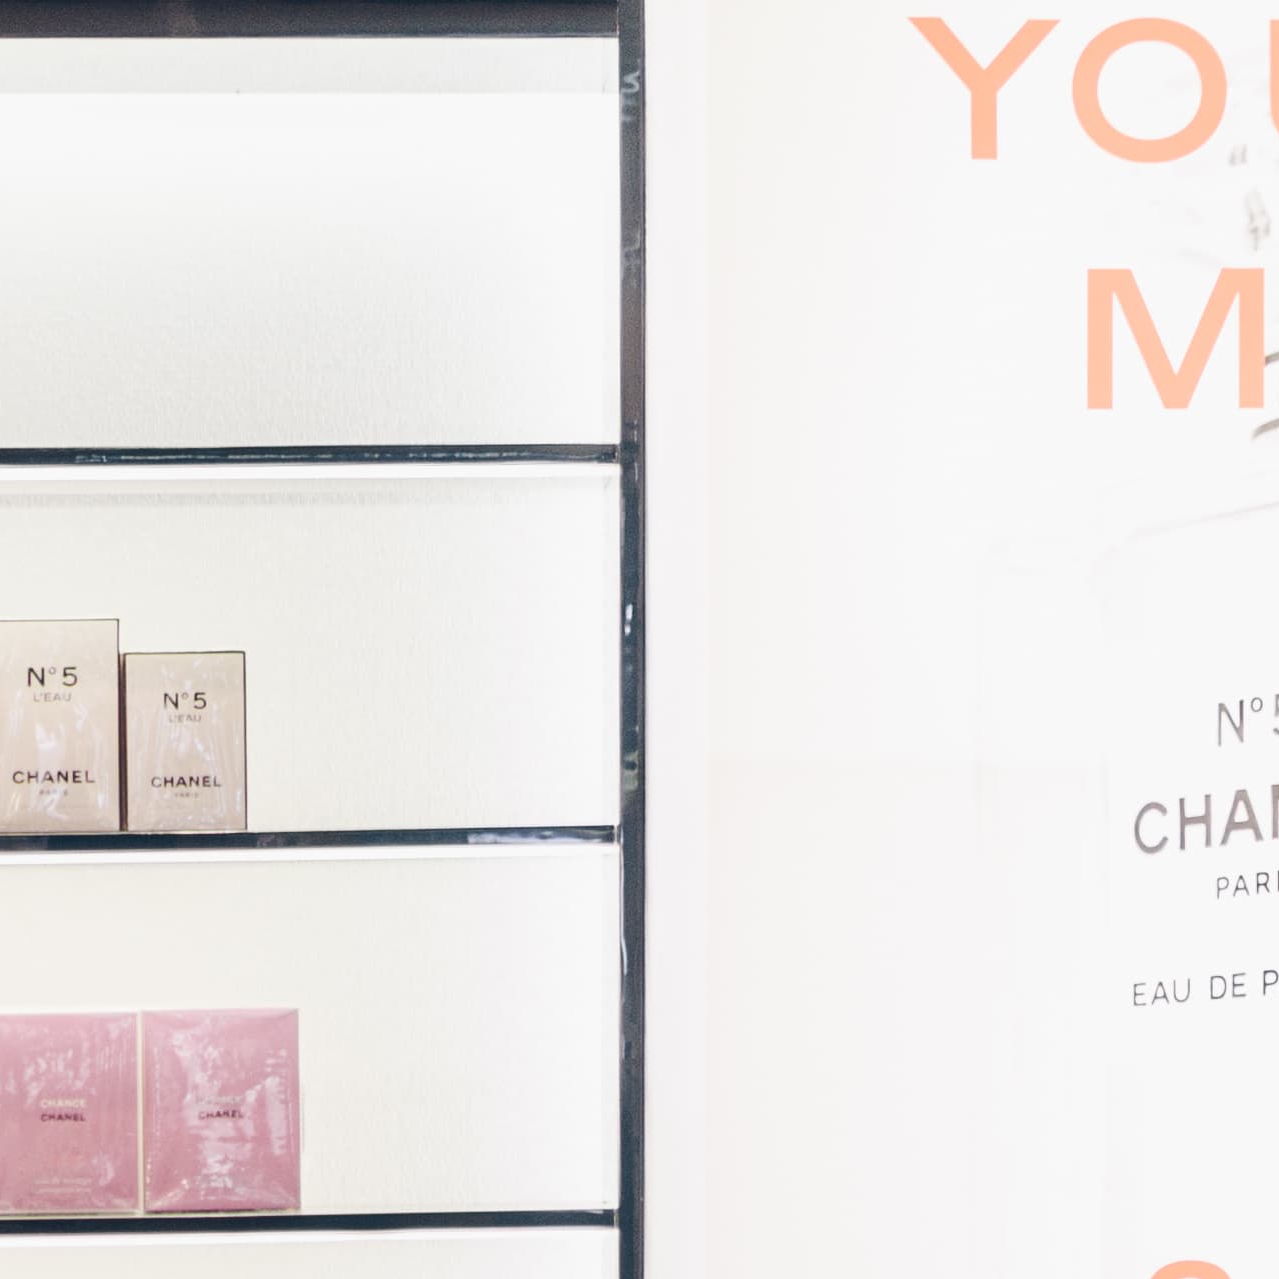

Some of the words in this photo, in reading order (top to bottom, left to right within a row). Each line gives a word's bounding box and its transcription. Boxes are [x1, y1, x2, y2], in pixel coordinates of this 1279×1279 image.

[12, 770, 96, 785] CHANEL
[151, 776, 222, 788] CHANEL
[1131, 977, 1192, 1007] EAU
[1209, 972, 1248, 1001] DE
[40, 1113, 86, 1122] CHANEL
